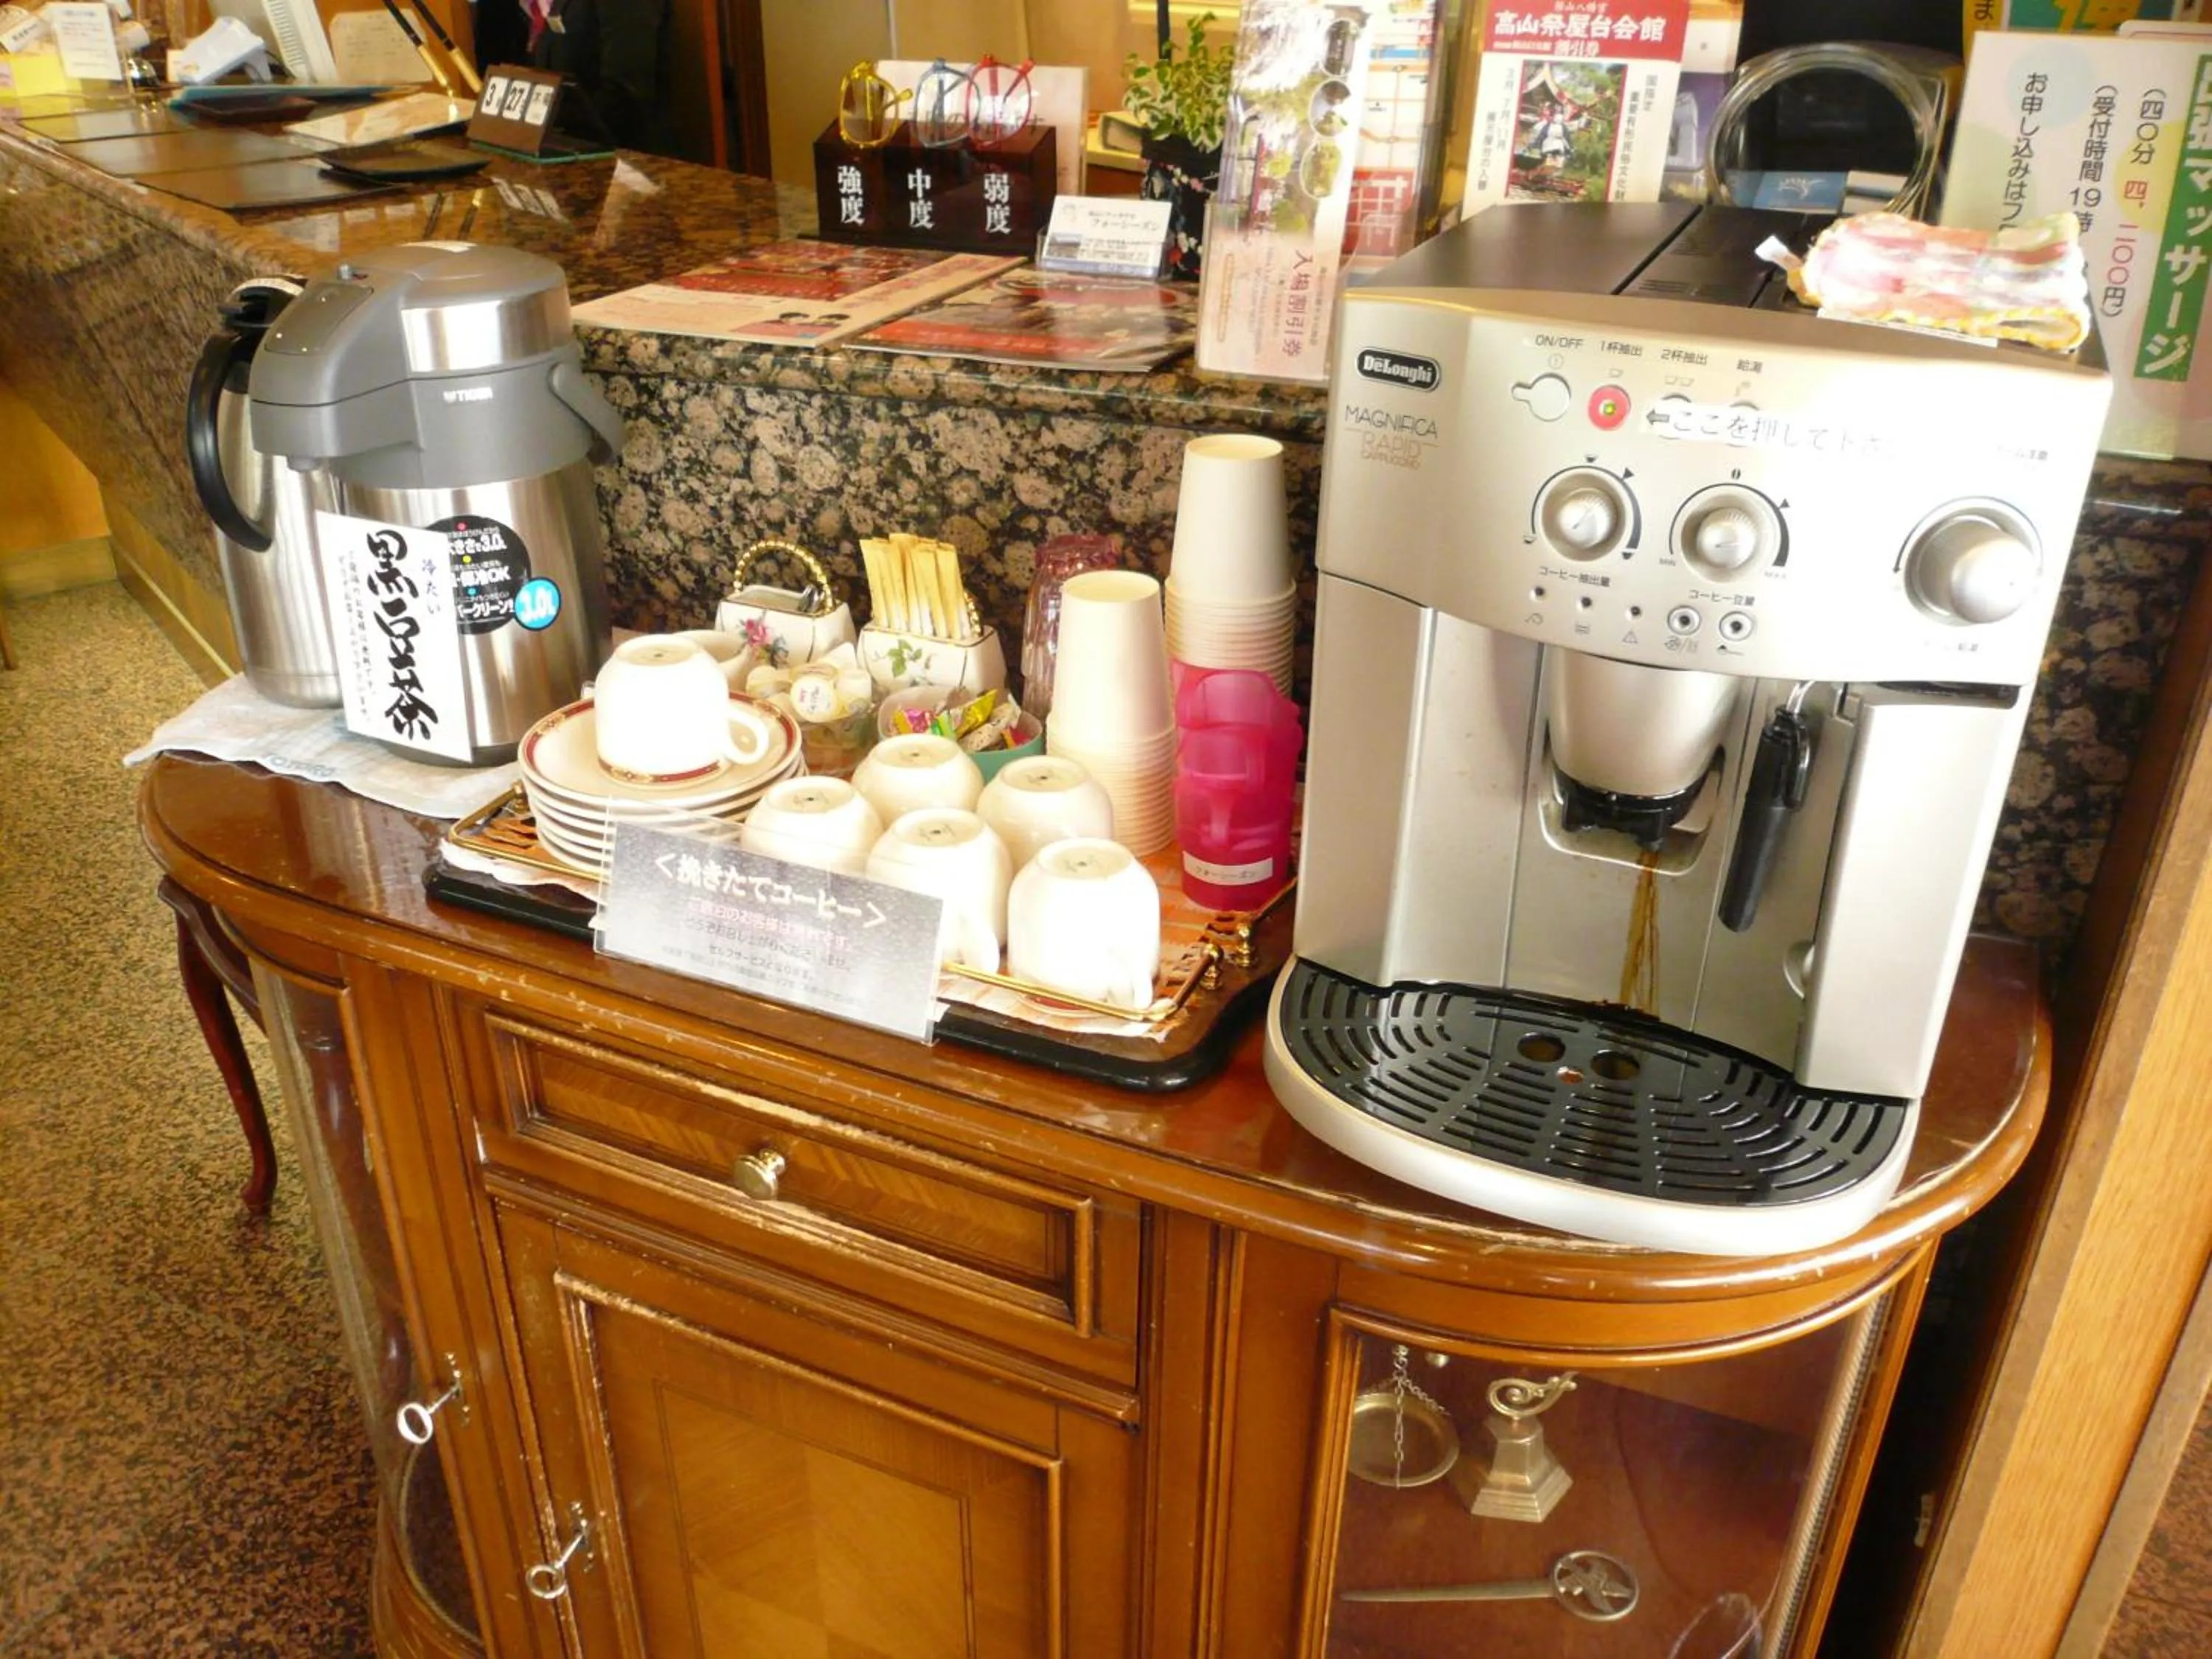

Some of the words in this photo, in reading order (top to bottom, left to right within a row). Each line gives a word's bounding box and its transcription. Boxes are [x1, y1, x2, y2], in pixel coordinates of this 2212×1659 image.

[1494, 10, 1666, 41] 高山祭屋台会館
[837, 164, 866, 226] 強度
[907, 167, 935, 229] 中度
[983, 173, 1012, 234] 弱度
[2143, 60, 2212, 374] マッサージ
[1534, 334, 1585, 349] ON/OFF
[1345, 404, 1438, 440] MAGNIFICA
